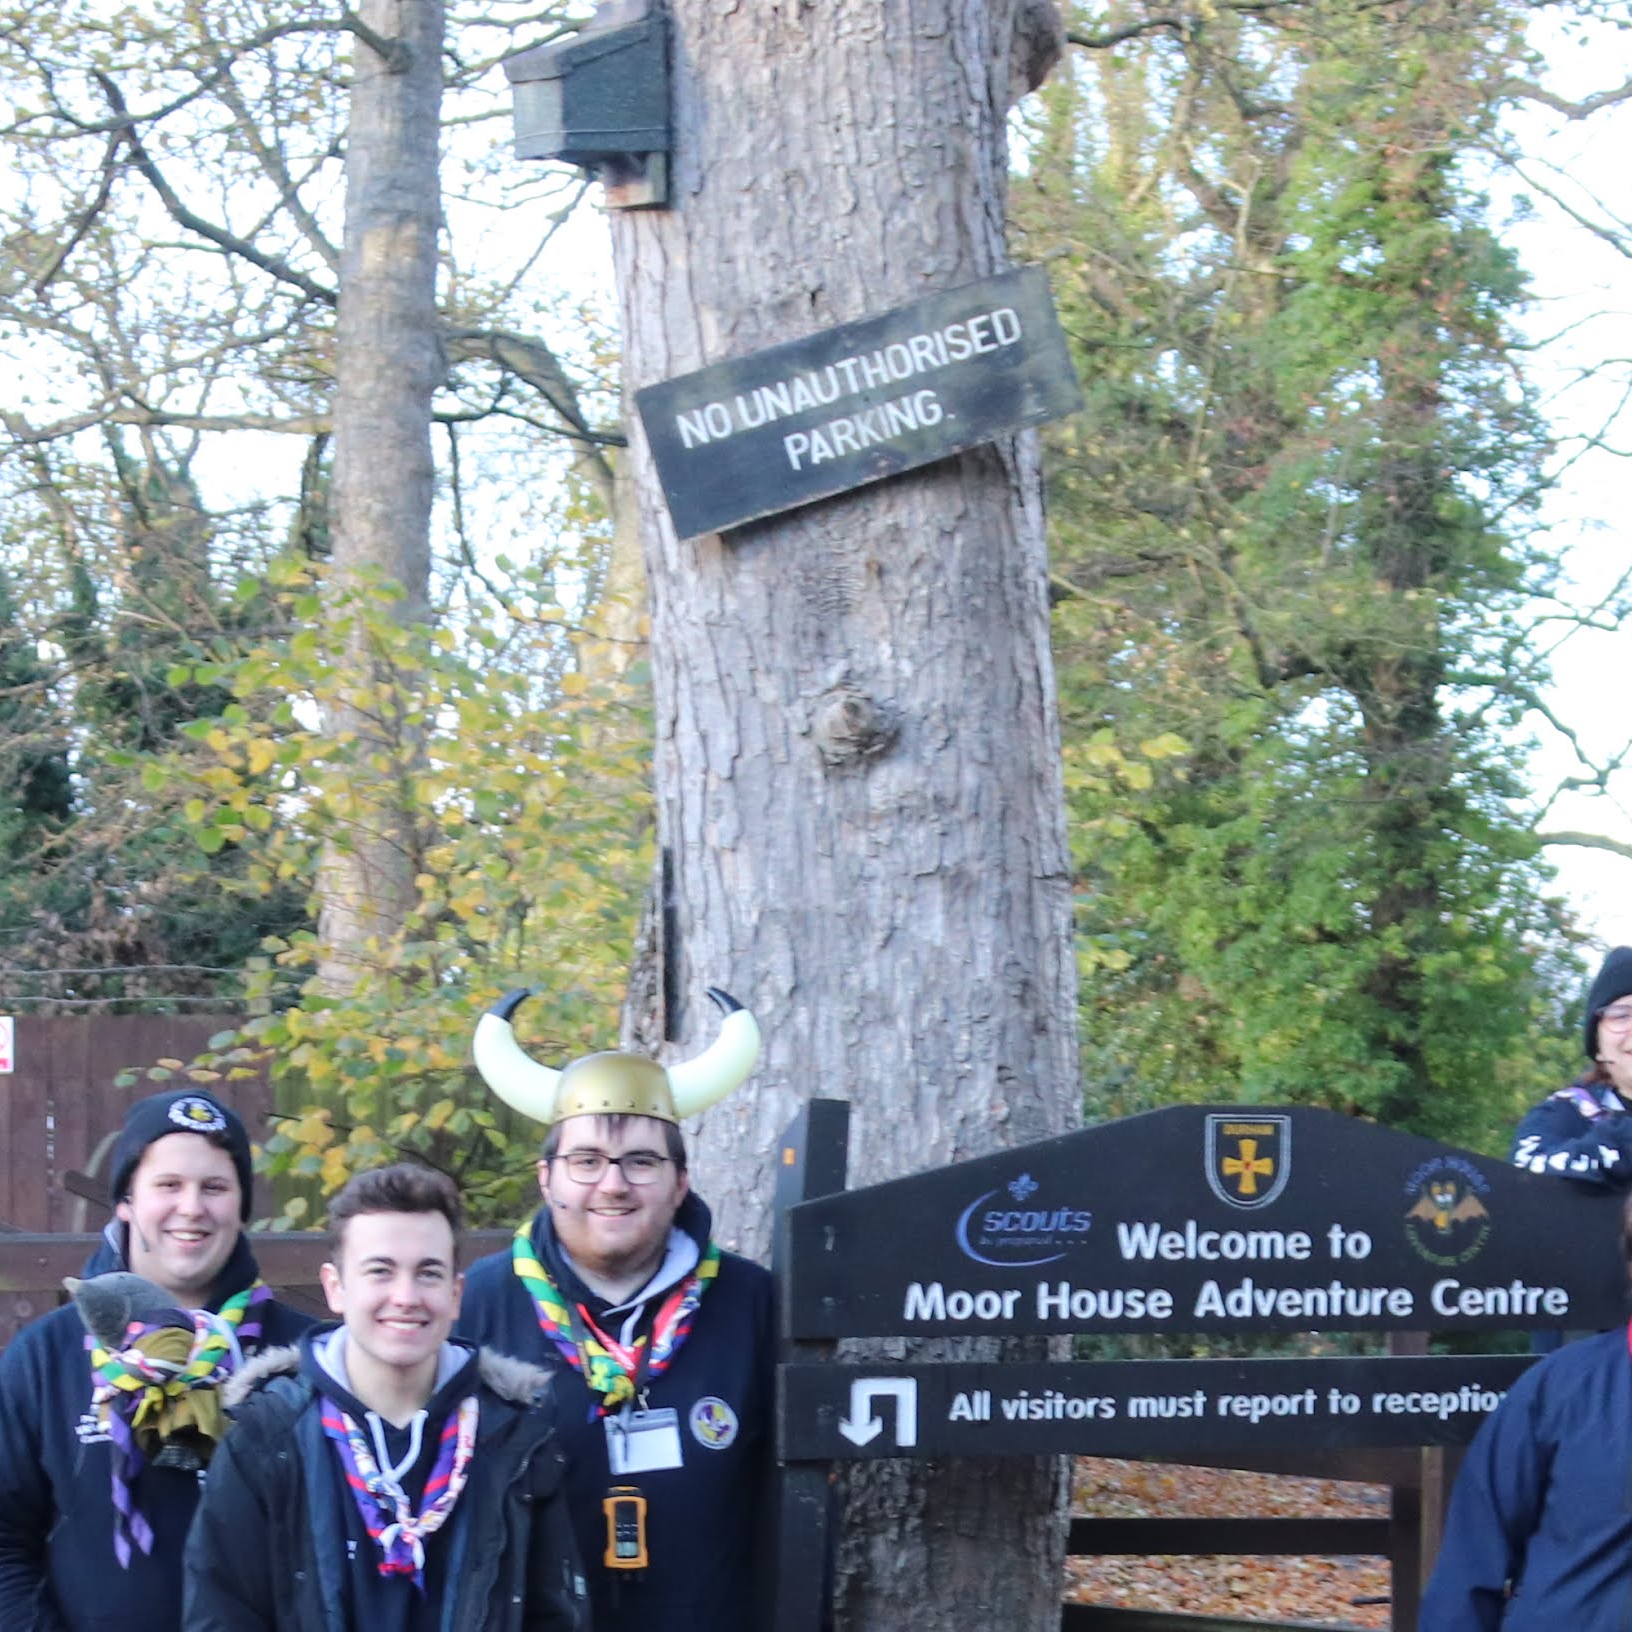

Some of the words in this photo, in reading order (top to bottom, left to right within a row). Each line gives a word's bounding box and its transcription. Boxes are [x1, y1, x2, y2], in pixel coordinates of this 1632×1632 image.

[675, 402, 733, 449] NO
[735, 307, 1023, 425] UNAUTHORISED
[983, 1206, 1092, 1232] scouts
[1117, 1220, 1312, 1260] Welcome
[1327, 1223, 1373, 1260] to
[903, 1281, 1022, 1322] Moor
[1036, 1280, 1174, 1321] House
[1193, 1277, 1414, 1318] Adventure
[1430, 1278, 1570, 1316] Centre
[948, 1389, 992, 1422] All
[1001, 1391, 1116, 1420] visitors
[1127, 1389, 1206, 1419] must
[1217, 1387, 1317, 1424] report
[1327, 1387, 1362, 1415] to
